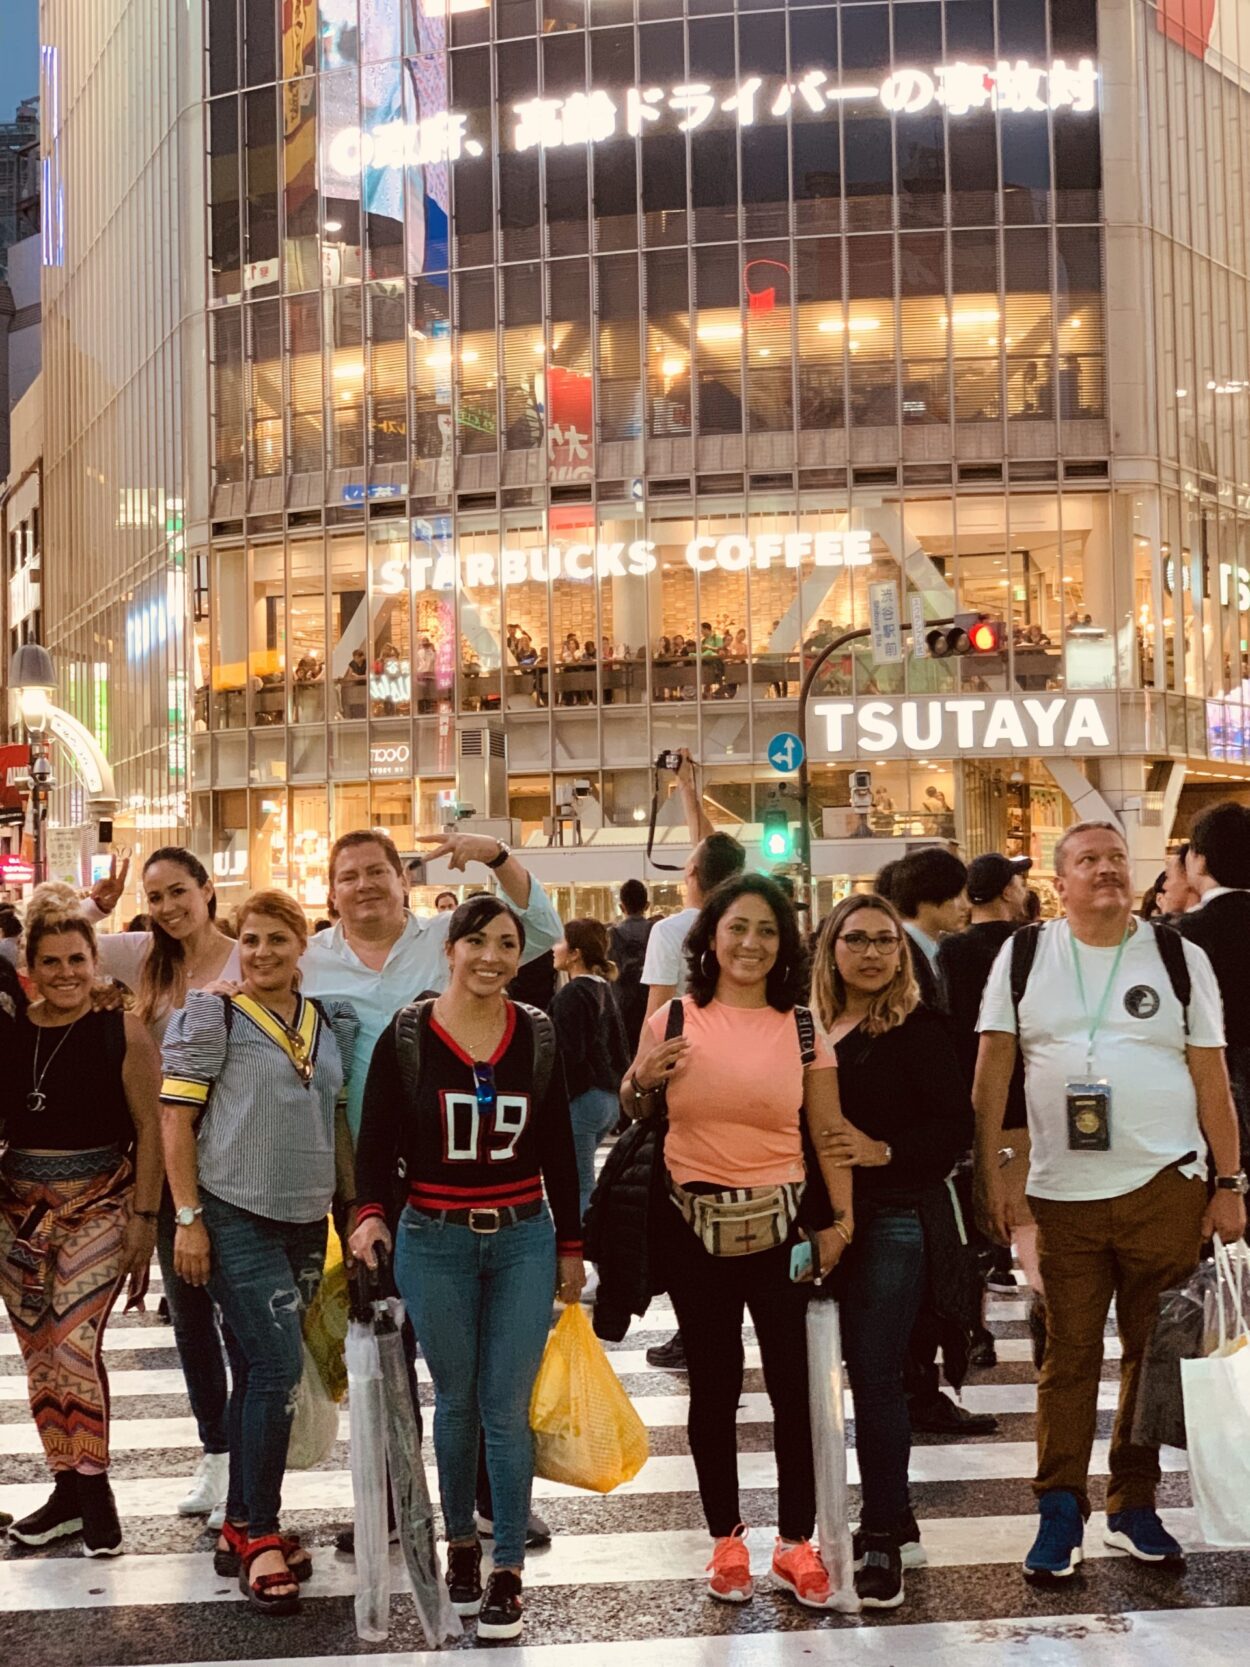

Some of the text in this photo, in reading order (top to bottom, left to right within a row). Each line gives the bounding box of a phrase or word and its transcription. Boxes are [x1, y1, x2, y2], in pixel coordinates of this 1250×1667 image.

[379, 530, 873, 595] STARBUCKS COFFEE
[814, 697, 1111, 754] TSUTAYA
